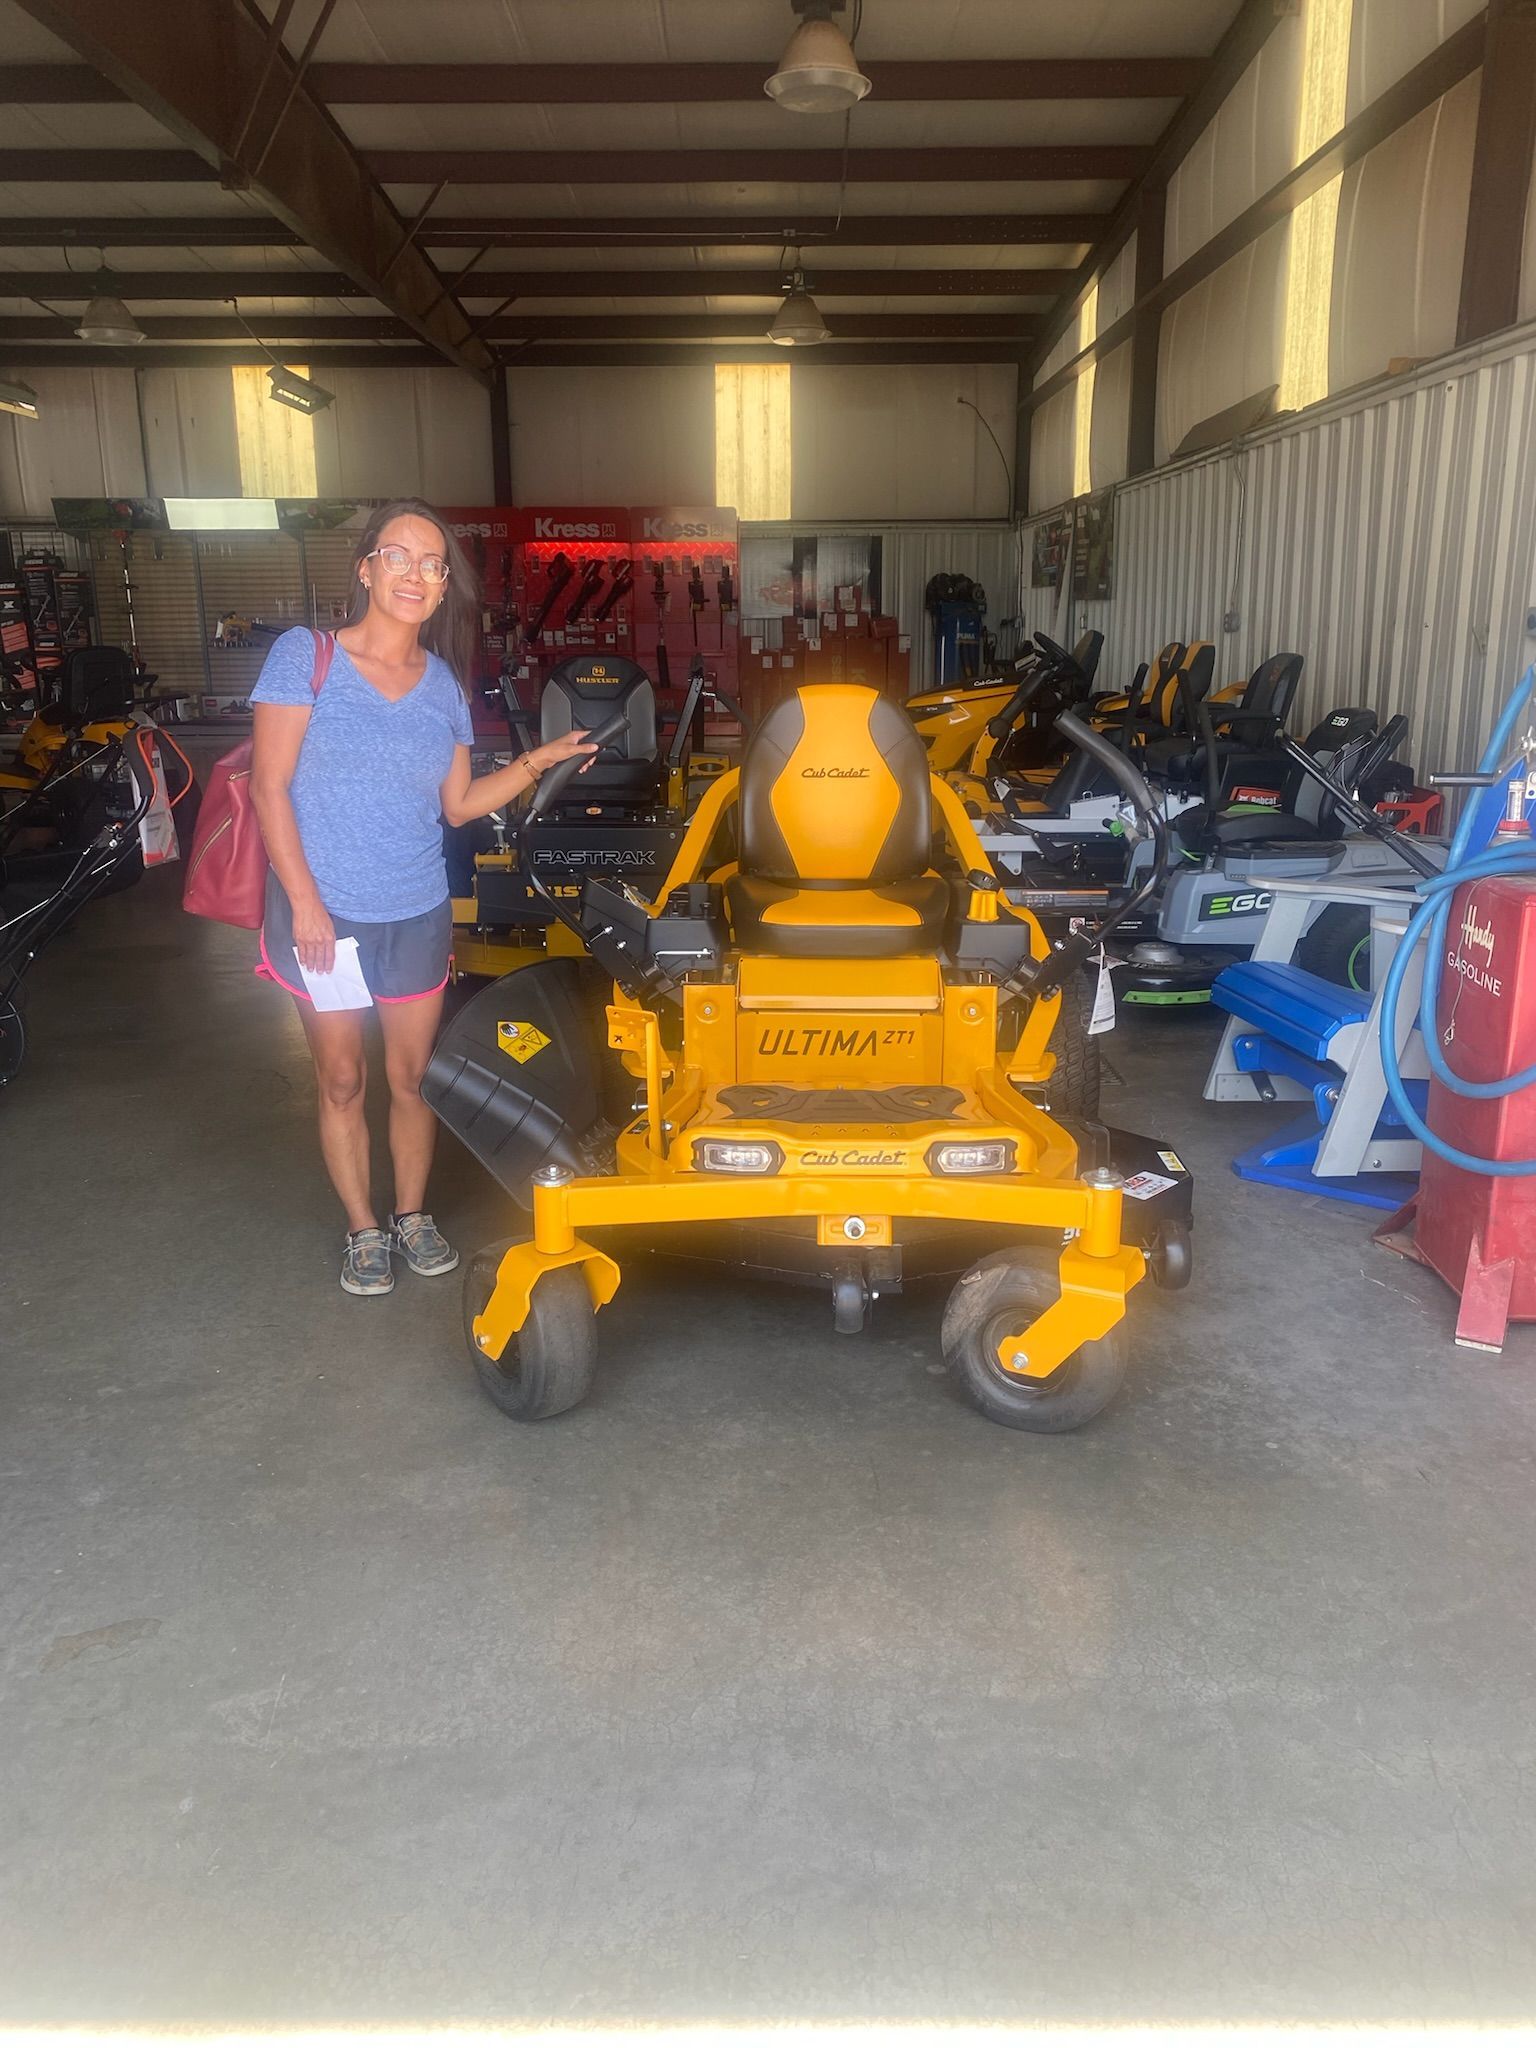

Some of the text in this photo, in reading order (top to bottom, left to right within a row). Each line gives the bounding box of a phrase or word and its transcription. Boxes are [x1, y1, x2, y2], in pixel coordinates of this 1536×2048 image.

[449, 523, 492, 538] ress
[535, 517, 600, 538] Kress
[643, 517, 709, 538] Kess
[1331, 716, 1349, 727] EGO
[801, 767, 870, 778] Cub Cadet
[1251, 796, 1277, 805] Bobcat
[533, 850, 656, 865] FASTRAK
[1461, 904, 1495, 968] Handy
[1447, 951, 1502, 997] GASOLINE
[758, 1029, 915, 1056] ULTIMA ZT1
[800, 1149, 906, 1166] Cub Cadet
